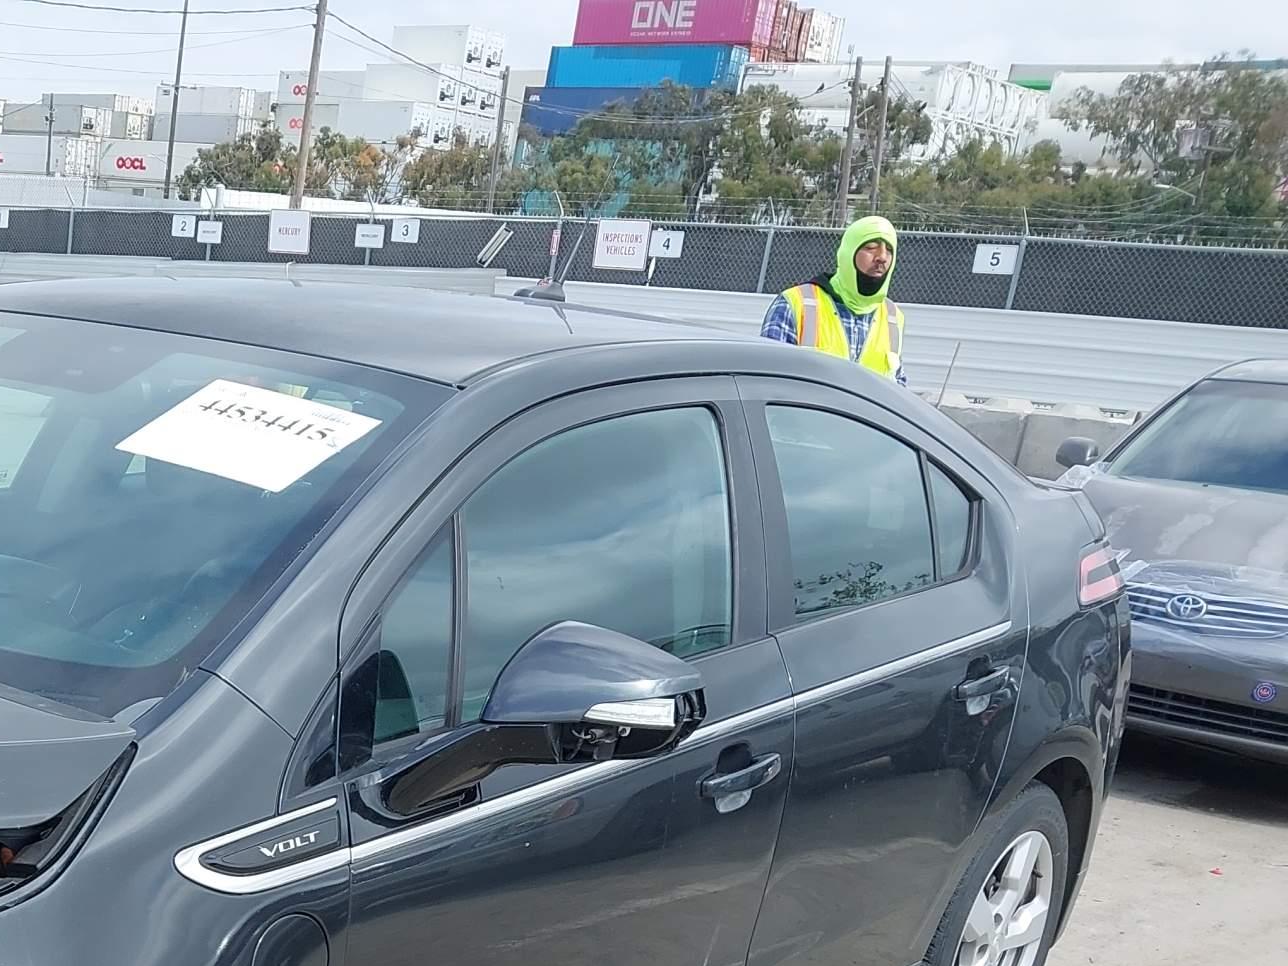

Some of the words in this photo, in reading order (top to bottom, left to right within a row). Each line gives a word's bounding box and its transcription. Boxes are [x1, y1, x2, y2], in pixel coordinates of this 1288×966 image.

[631, 0, 696, 28] ONE
[116, 156, 146, 171] OOCL
[180, 220, 187, 232] 2
[402, 224, 409, 237] 3
[602, 232, 643, 244] INSPECTIONS
[662, 237, 671, 251] 4
[606, 245, 636, 256] VEHICLES
[990, 251, 1001, 267] 5
[199, 399, 336, 440] 44534415
[257, 830, 320, 858] VOLT
